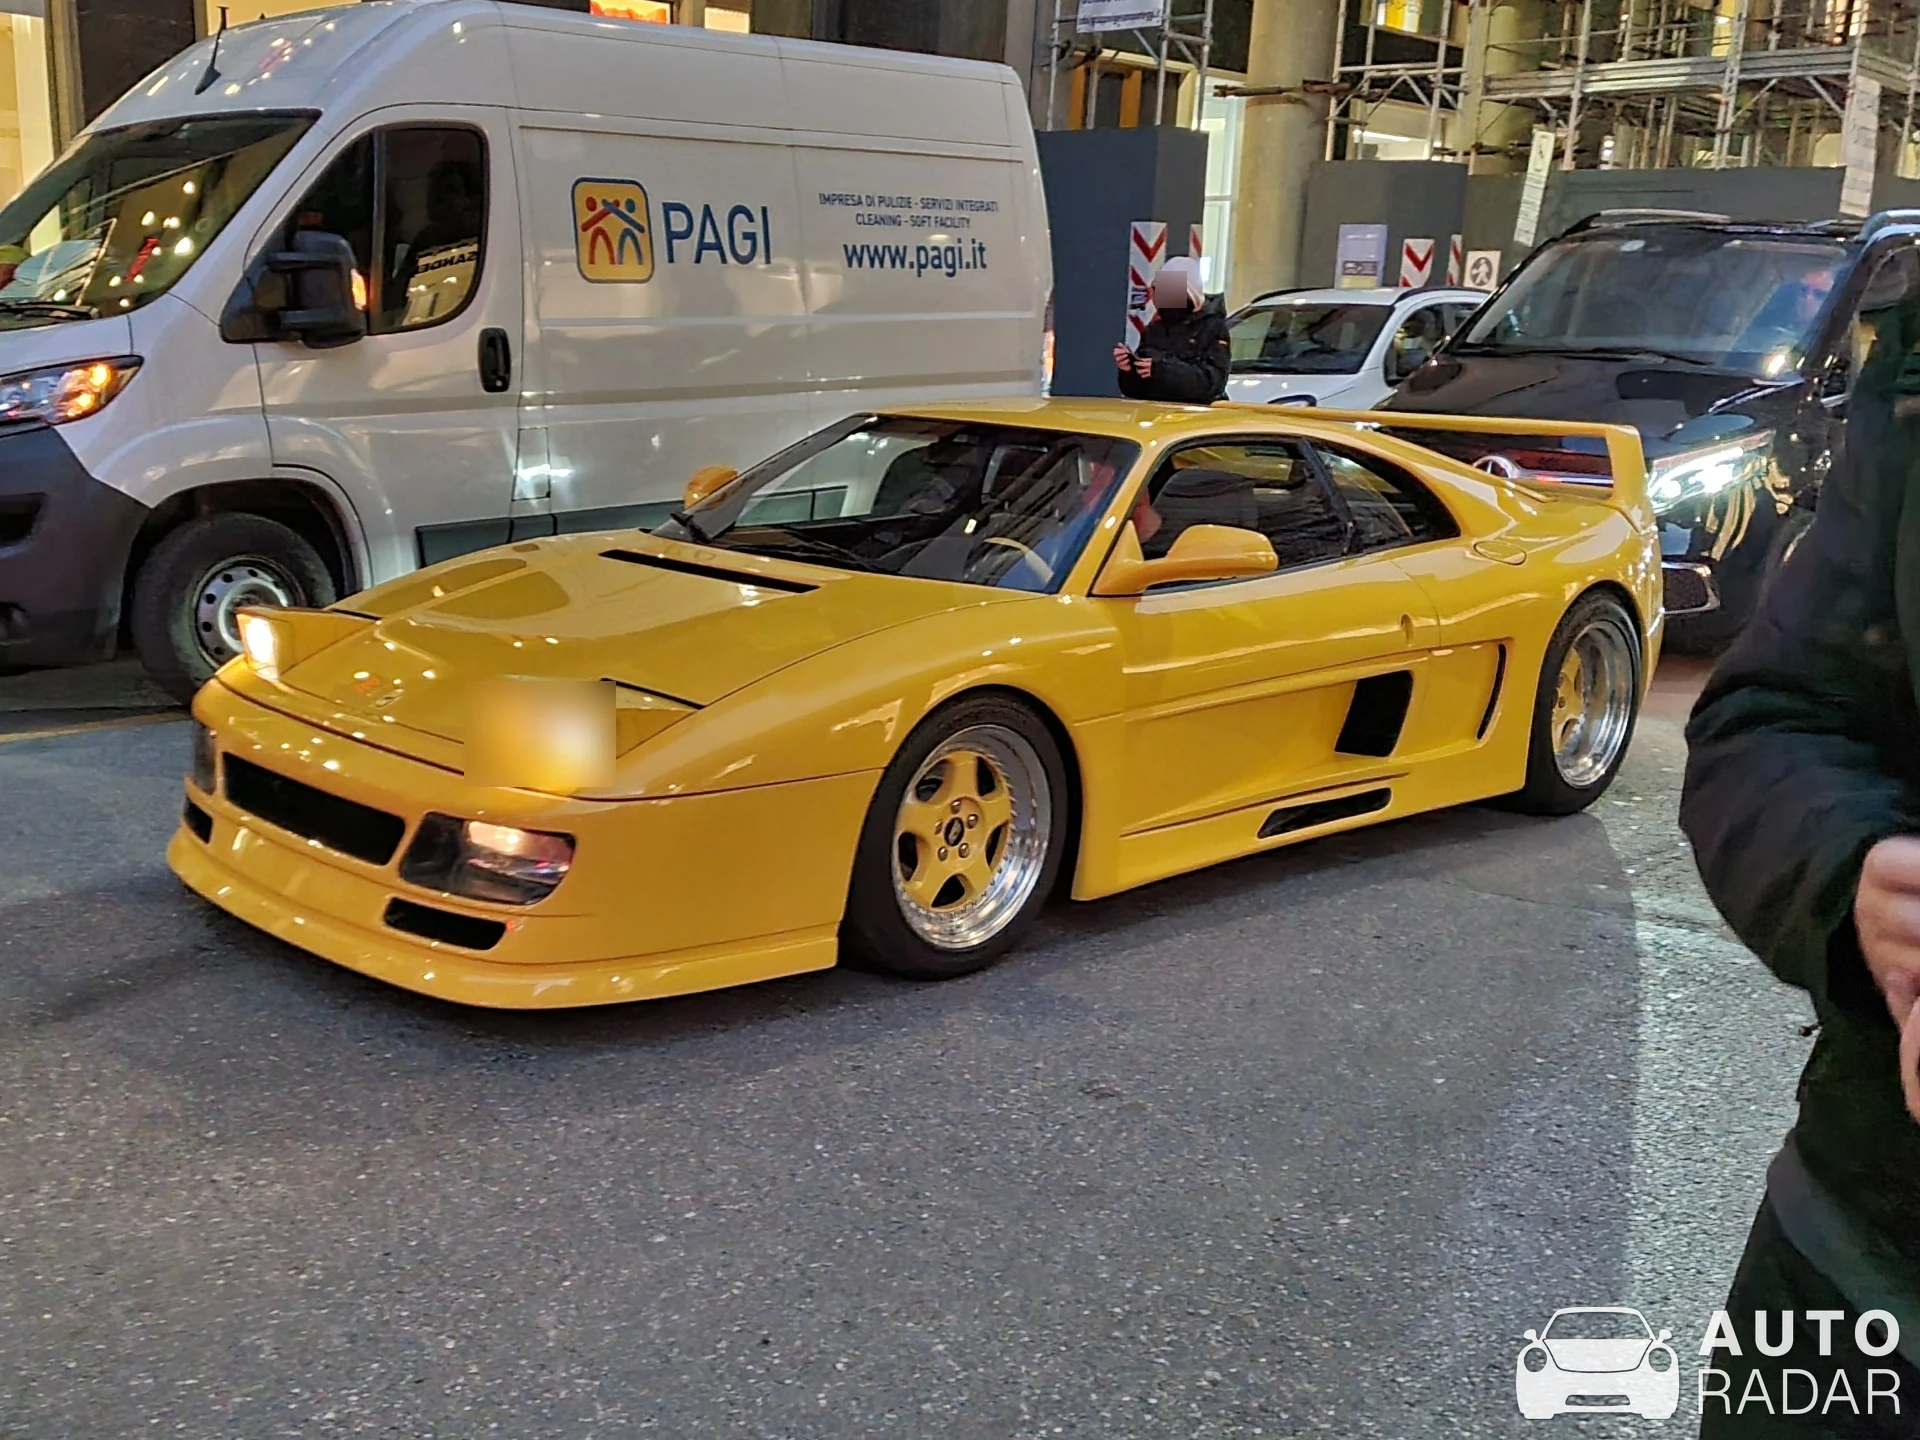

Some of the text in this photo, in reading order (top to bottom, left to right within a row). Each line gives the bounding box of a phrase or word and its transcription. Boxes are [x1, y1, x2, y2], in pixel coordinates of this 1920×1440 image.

[819, 193, 862, 207] IMPRESA
[866, 195, 875, 207] DI
[878, 196, 912, 209] PULIZIE
[920, 197, 953, 210] SERVIZI
[956, 199, 998, 212] INTEGRATI
[662, 202, 771, 265] PAGI
[856, 213, 902, 227] CLEANING
[910, 215, 932, 228] SOFT
[934, 216, 971, 229] FACILITY
[843, 238, 987, 277] www.pagi.it
